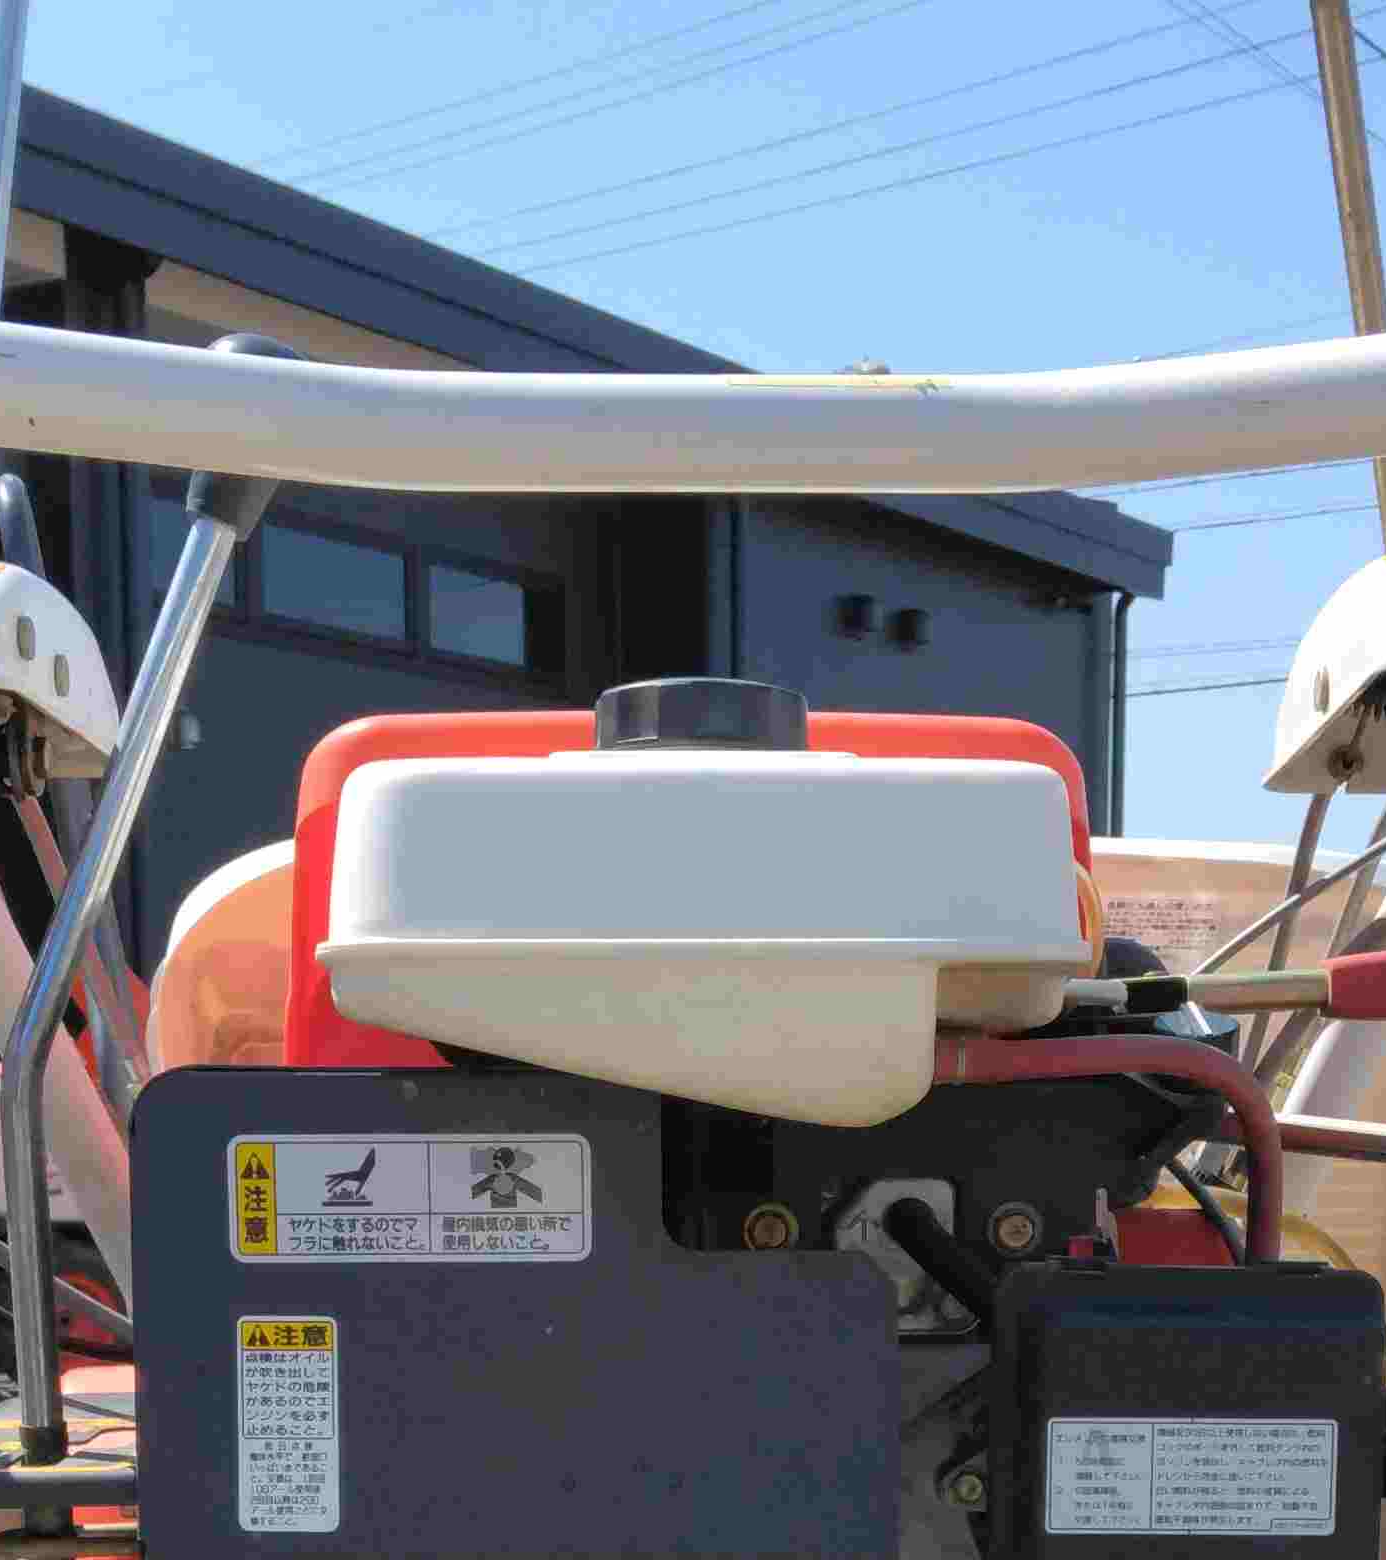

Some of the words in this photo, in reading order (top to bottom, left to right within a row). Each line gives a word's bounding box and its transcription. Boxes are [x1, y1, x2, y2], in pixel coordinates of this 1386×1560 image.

[244, 1185, 270, 1244] 注意
[288, 1216, 419, 1233] ヤケドをするのでマ
[274, 1325, 329, 1347] 注意
